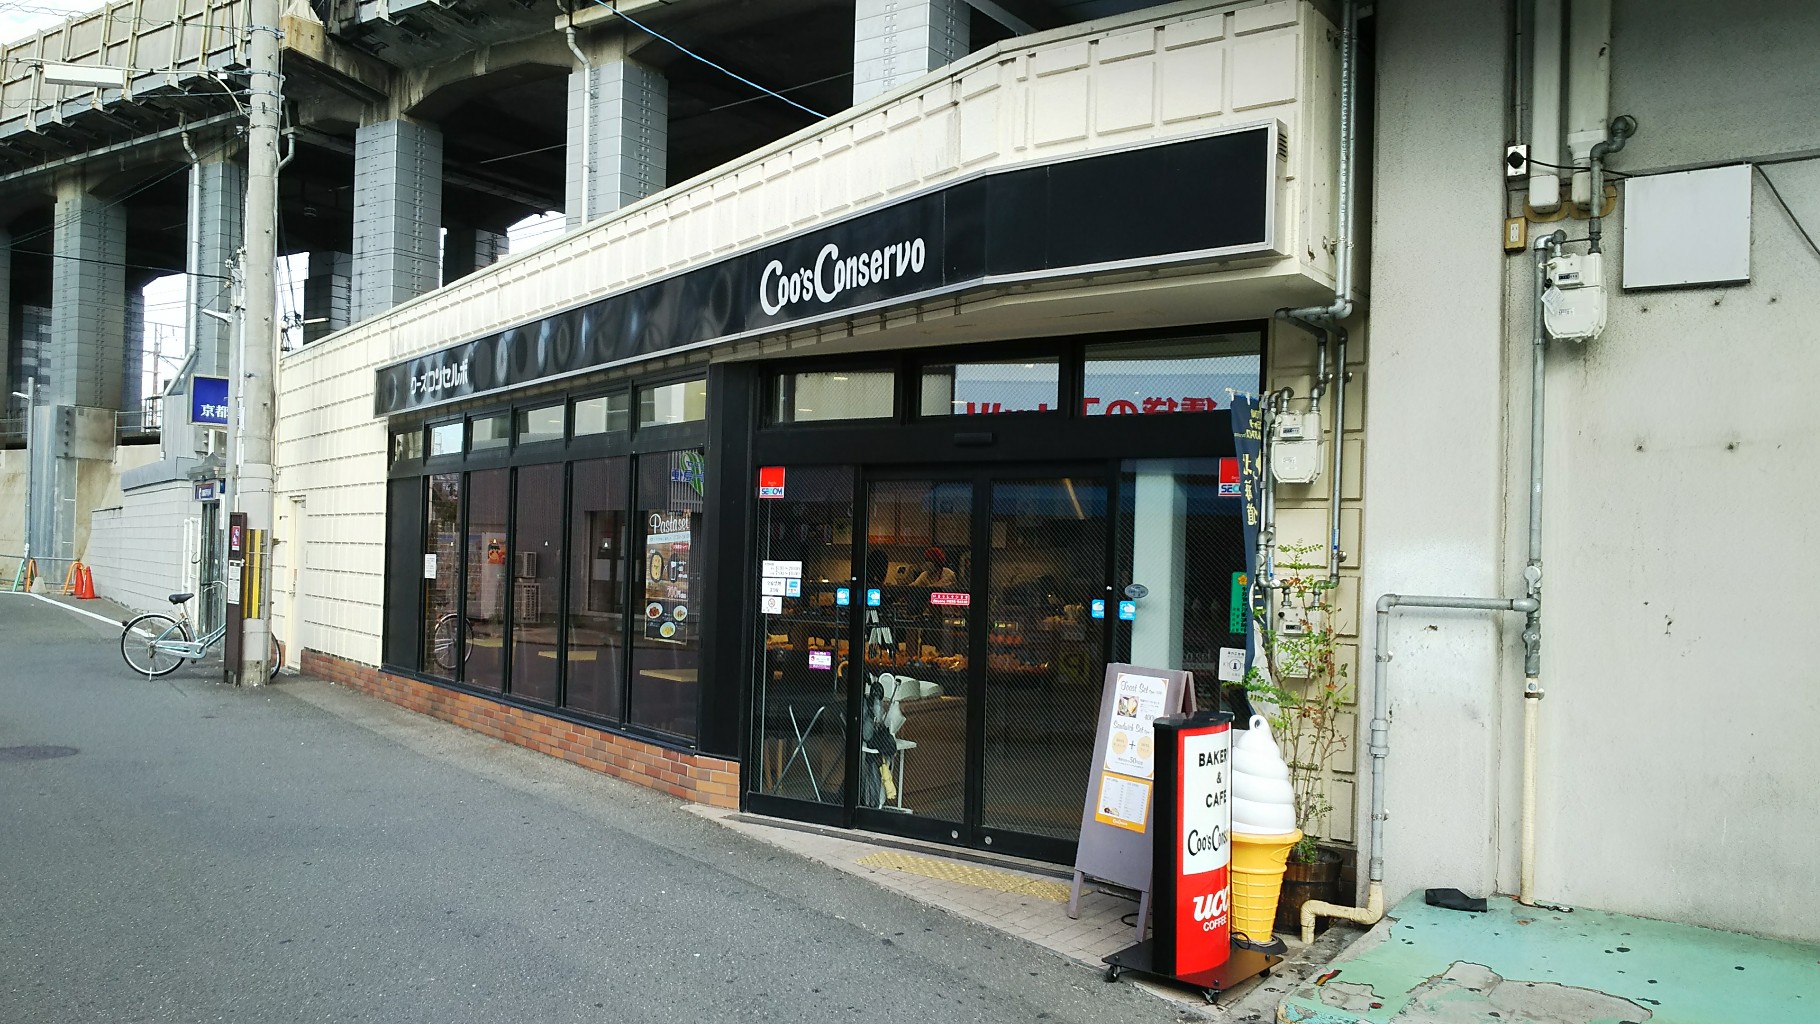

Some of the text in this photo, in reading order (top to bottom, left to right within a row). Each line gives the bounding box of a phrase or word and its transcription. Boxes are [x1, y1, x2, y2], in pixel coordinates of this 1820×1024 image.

[760, 238, 925, 315] Coo's Conservo
[411, 359, 468, 394] クーズコンセルボ
[200, 404, 229, 418] 京都
[1221, 484, 1241, 492] SEC
[1199, 747, 1229, 767] BAKER
[1216, 771, 1222, 784] &
[1188, 829, 1211, 856] Coo's
